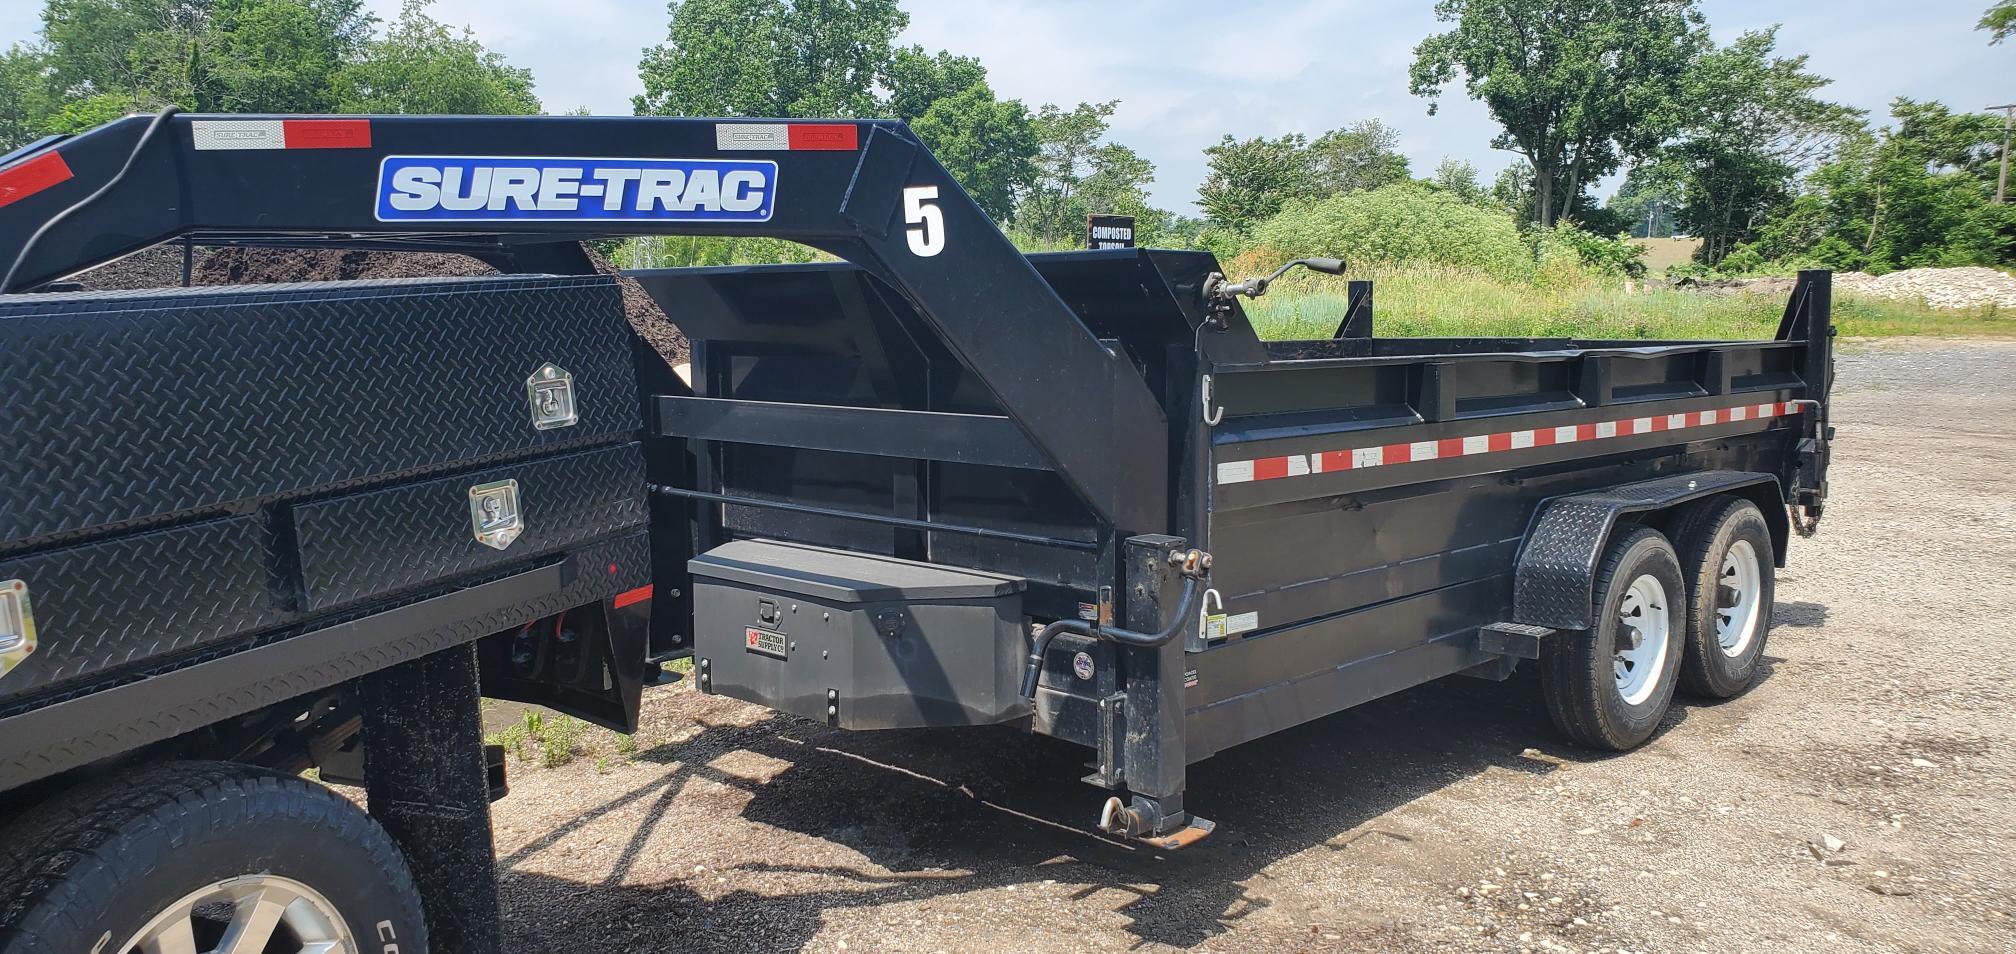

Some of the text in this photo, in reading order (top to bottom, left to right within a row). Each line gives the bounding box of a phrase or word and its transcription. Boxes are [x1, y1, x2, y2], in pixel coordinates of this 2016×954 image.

[389, 166, 766, 212] SURE-TRAC
[903, 185, 945, 257] 5
[1093, 226, 1131, 240] COMPOSTED
[758, 633, 784, 645] TRACTOR
[758, 640, 777, 652] SUPPLY
